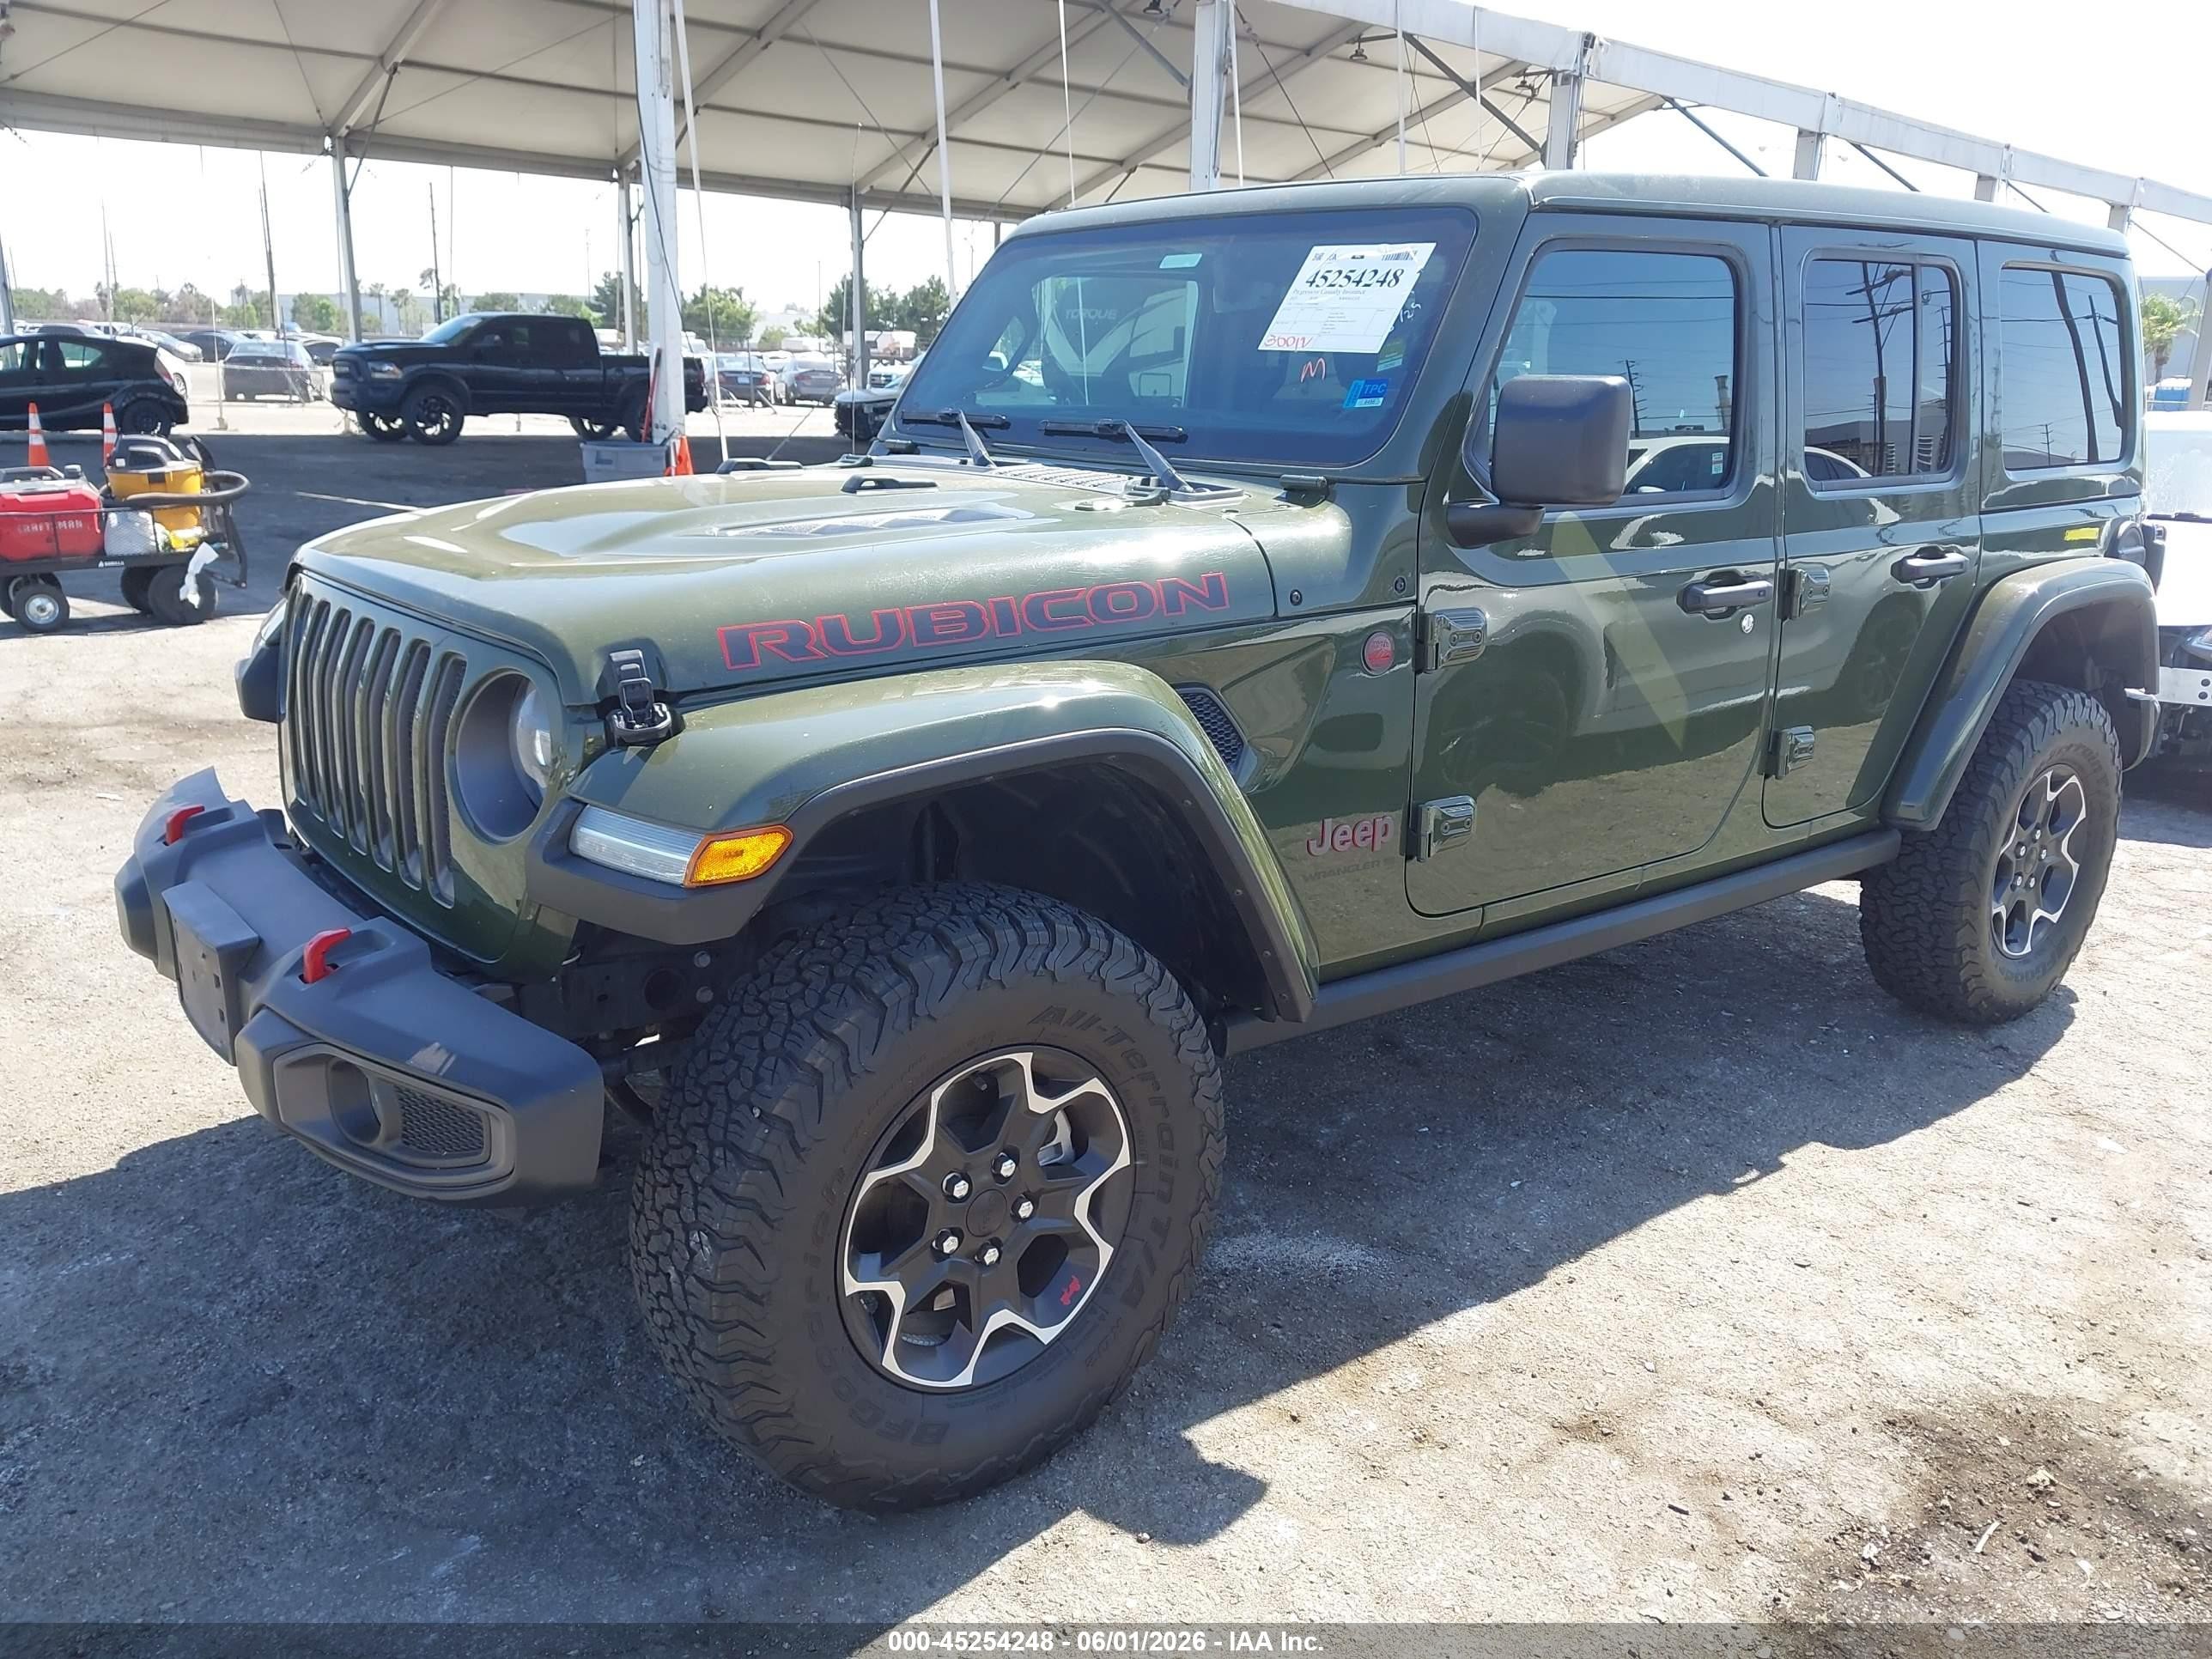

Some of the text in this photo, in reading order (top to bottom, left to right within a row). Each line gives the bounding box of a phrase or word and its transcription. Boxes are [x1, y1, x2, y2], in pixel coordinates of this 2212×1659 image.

[1305, 268, 1405, 289] 45254248
[1064, 307, 1119, 320] TORQUE
[716, 571, 1231, 671] RUBICON
[1306, 815, 1395, 857] Jeep
